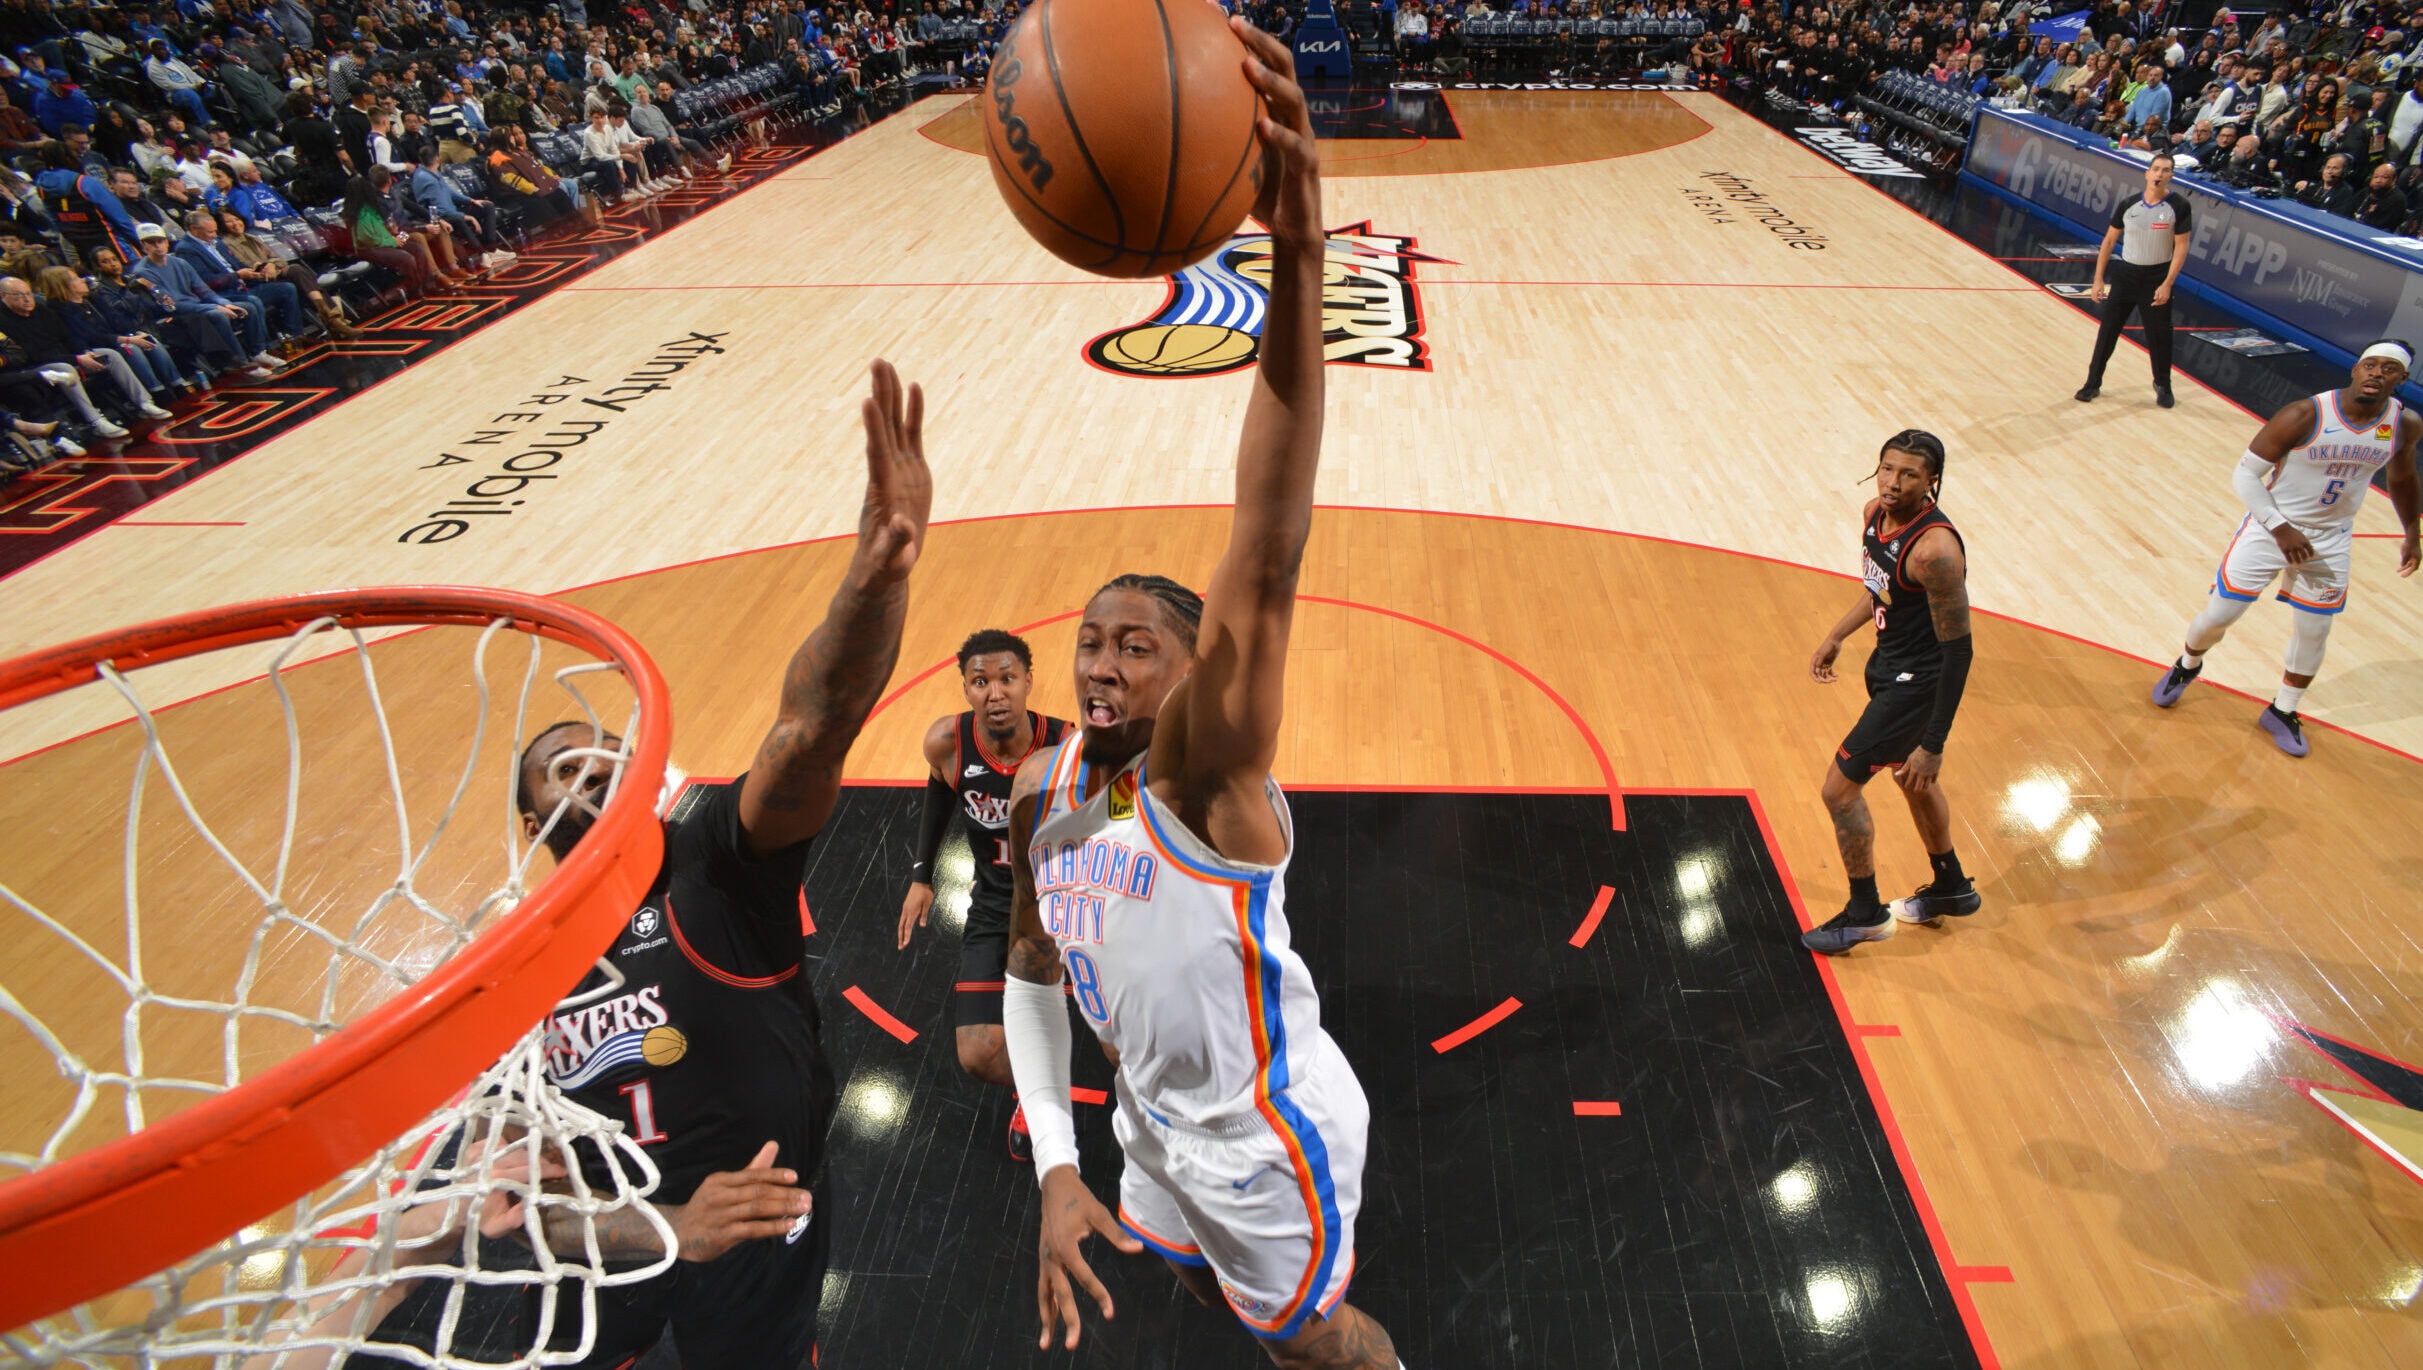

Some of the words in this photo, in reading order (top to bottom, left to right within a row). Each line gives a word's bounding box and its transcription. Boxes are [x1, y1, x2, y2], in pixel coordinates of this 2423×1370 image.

[1455, 82, 1700, 91] crypto.com
[1794, 127, 1927, 178] betway
[1677, 188, 1737, 224] ARENA
[1699, 171, 1770, 205] xfinity
[1744, 206, 1830, 250] mobile
[2042, 153, 2112, 213] 76ERS
[2211, 225, 2288, 286] APP
[2288, 266, 2336, 306] NJM
[0, 146, 814, 534] PHILADELPH
[581, 331, 731, 412] xfinity
[418, 375, 592, 470] ARENA
[397, 420, 610, 544] mobile
[2307, 443, 2392, 467] OKLAHOMA
[2323, 462, 2361, 478] CITY
[2319, 478, 2347, 507] 5
[1871, 603, 1887, 631] 6
[964, 789, 1011, 823] SIX
[1113, 801, 1135, 816] Love
[1029, 838, 1158, 902] KLAHOMA
[1048, 890, 1106, 945] CITY
[621, 937, 668, 956] crypto.com
[1064, 946, 1112, 1026] 8
[543, 985, 669, 1078] IXERS
[618, 1079, 669, 1147] 1
